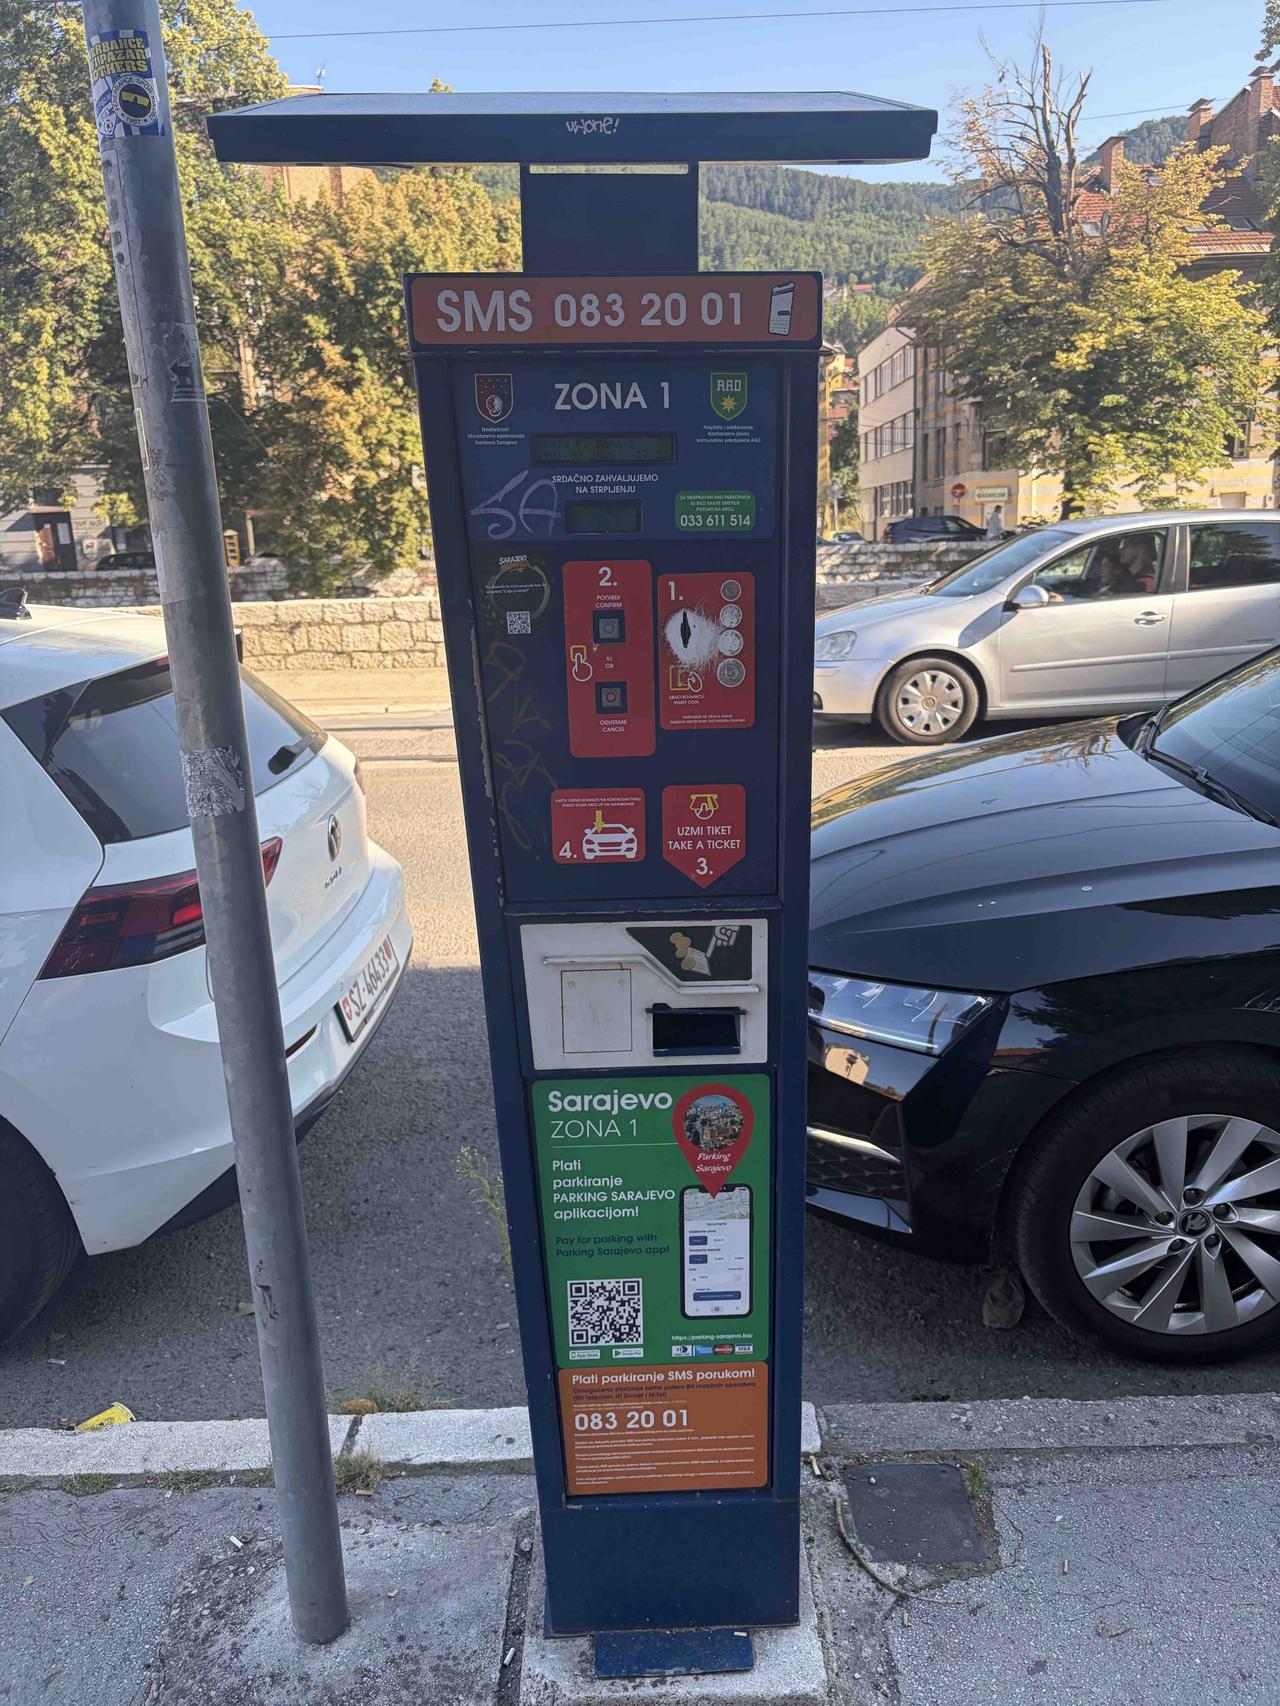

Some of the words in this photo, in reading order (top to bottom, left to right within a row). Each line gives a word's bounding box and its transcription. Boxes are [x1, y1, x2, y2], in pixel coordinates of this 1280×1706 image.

[436, 289, 533, 332] SMS
[554, 293, 625, 327] 083
[640, 292, 687, 326] 20
[701, 292, 740, 326] 01
[716, 379, 742, 392] RAD
[554, 382, 648, 410] ZONA
[660, 382, 669, 409] 1
[551, 473, 594, 483] SRDAČNO
[595, 473, 659, 482] ZAHVALJUJEMO
[575, 486, 589, 494] NA
[590, 485, 636, 494] STRPLJENJU
[680, 515, 703, 527] 033
[706, 515, 725, 527] 611
[729, 514, 751, 526] 514
[598, 566, 618, 587] 2.
[668, 581, 684, 601] 1.
[677, 827, 704, 836] UZMI
[706, 826, 732, 835] TIKET
[559, 841, 577, 859] 4.
[668, 840, 693, 850] TAKE
[696, 840, 704, 850] A
[707, 839, 741, 849] TICKET
[696, 857, 714, 875] 3.
[548, 1089, 673, 1116] Sarajevo
[551, 1119, 621, 1139] ZONA
[629, 1118, 637, 1136] 1
[697, 1152, 731, 1163] Parking
[552, 1159, 581, 1171] Plati
[695, 1163, 732, 1174] Sarajevo
[553, 1176, 623, 1190] parkiranje
[553, 1191, 608, 1203] PARKING
[611, 1189, 675, 1201] SARAJEVO
[553, 1206, 639, 1221] aplikacijom!
[556, 1236, 577, 1246] Pay
[577, 1235, 591, 1244] for
[593, 1234, 634, 1245] parking
[636, 1233, 657, 1242] with
[556, 1247, 594, 1258] Parking
[597, 1246, 642, 1257] Sarajevo
[645, 1245, 670, 1255] app!
[572, 1373, 598, 1385] Plati
[601, 1371, 665, 1385] parkiranje
[668, 1370, 693, 1381] SMS
[696, 1368, 755, 1381] porukom!
[574, 1412, 618, 1431] 083
[626, 1410, 655, 1429] 20
[662, 1409, 688, 1427] 01
